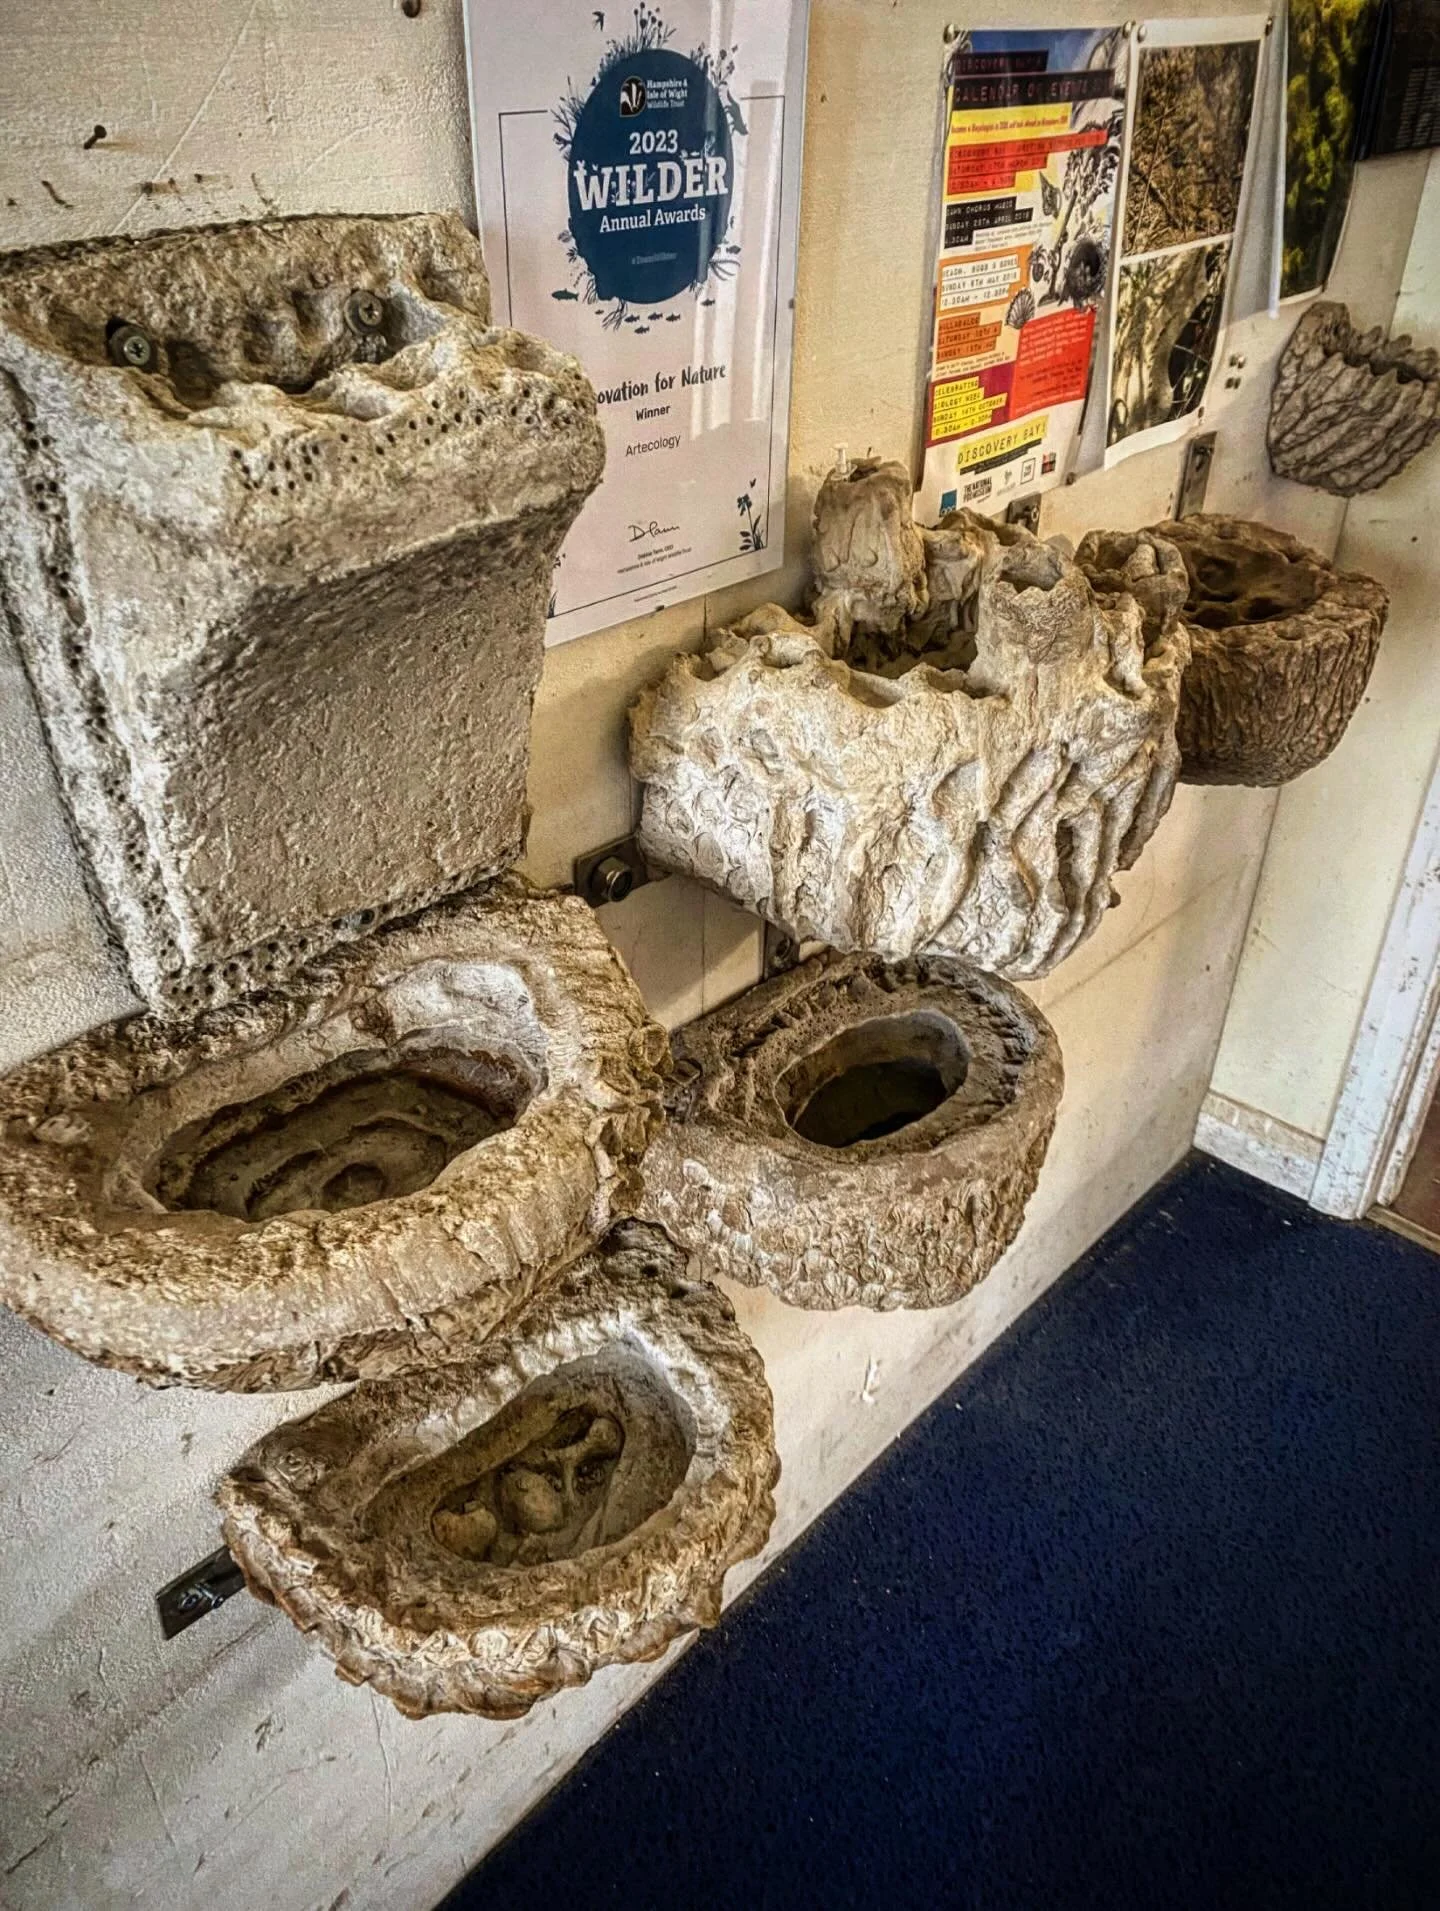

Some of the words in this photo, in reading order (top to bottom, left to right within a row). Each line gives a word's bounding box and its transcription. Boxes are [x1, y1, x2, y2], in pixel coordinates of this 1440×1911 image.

[647, 78, 682, 89] Hampshire
[647, 90, 659, 99] Isle
[660, 89, 668, 98] of
[669, 88, 688, 100] Wight
[629, 129, 678, 155] 2023
[573, 157, 728, 211] WILDER
[600, 208, 651, 233] Annual
[653, 203, 706, 227] Awards
[655, 371, 676, 393] for
[681, 364, 727, 388] Nature
[636, 404, 672, 421] Winner
[625, 435, 681, 457] Artecology
[958, 433, 1018, 466] DISCOVERY
